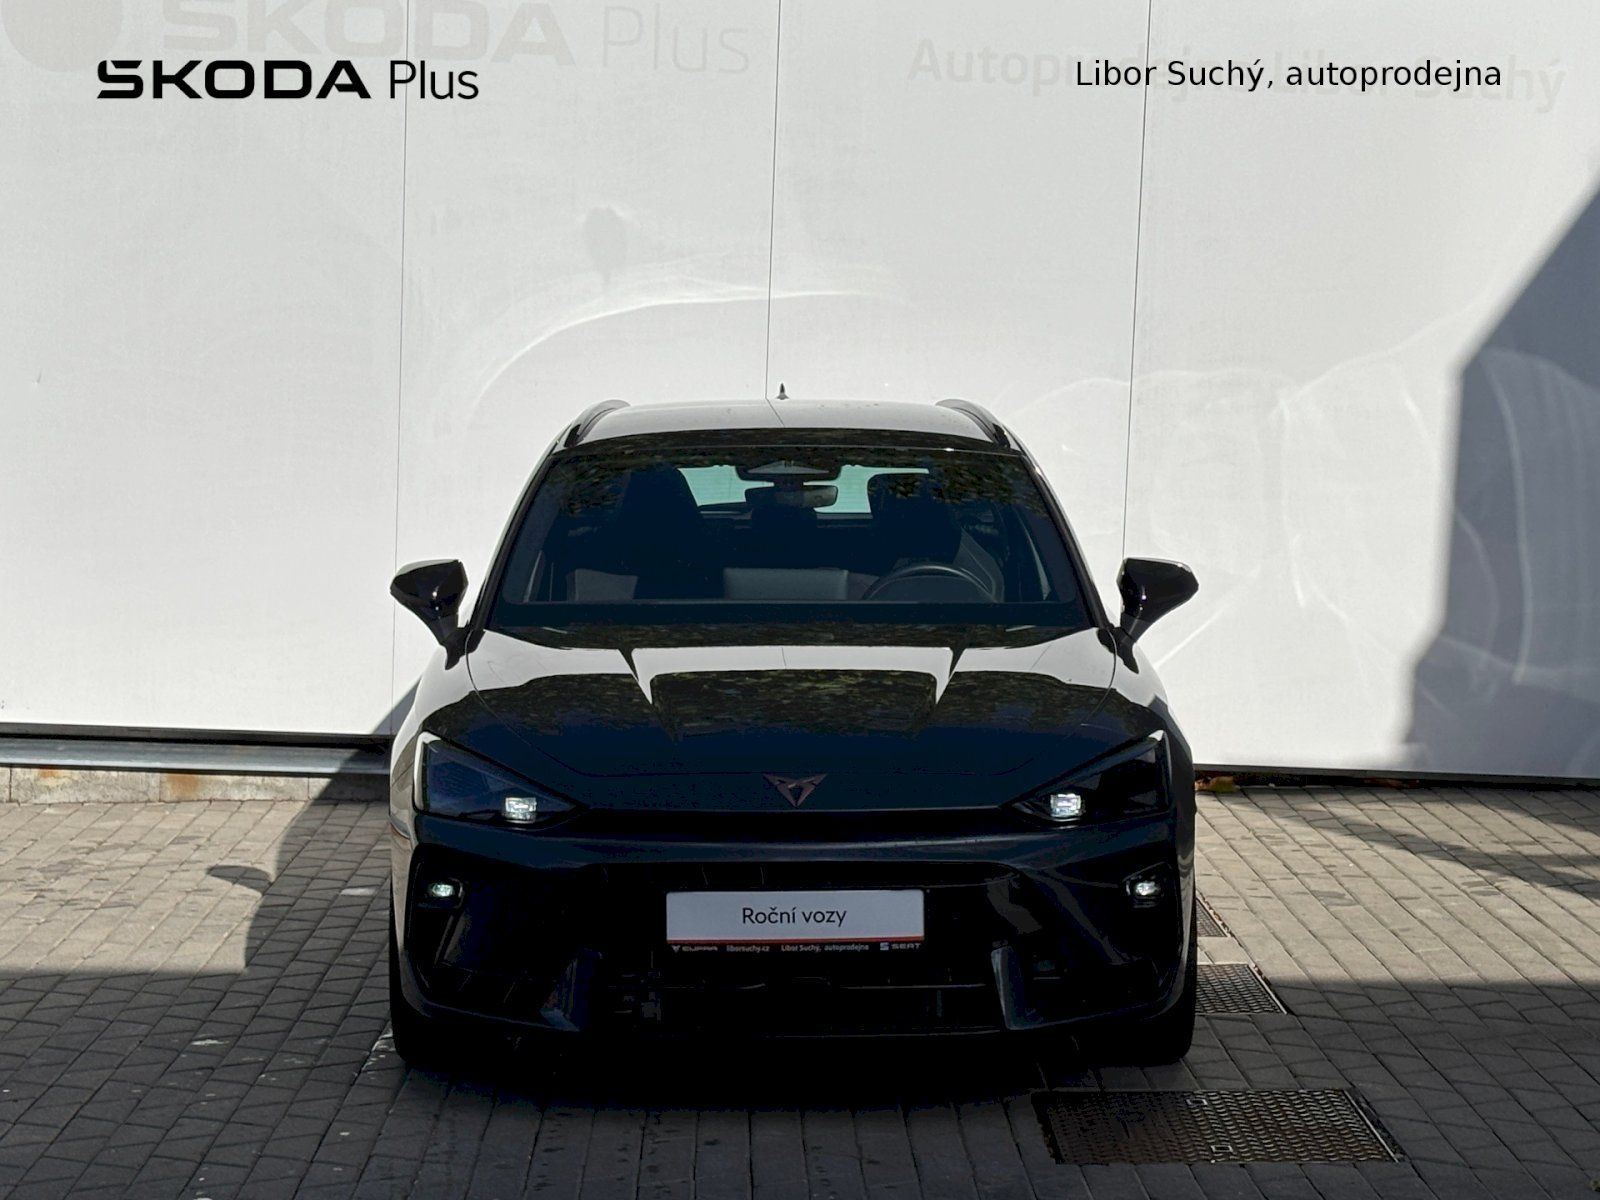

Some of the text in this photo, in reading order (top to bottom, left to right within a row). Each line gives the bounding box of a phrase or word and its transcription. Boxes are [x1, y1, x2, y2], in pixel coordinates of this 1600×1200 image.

[602, 5, 749, 74] Plus
[743, 906, 847, 928] Roční vozy
